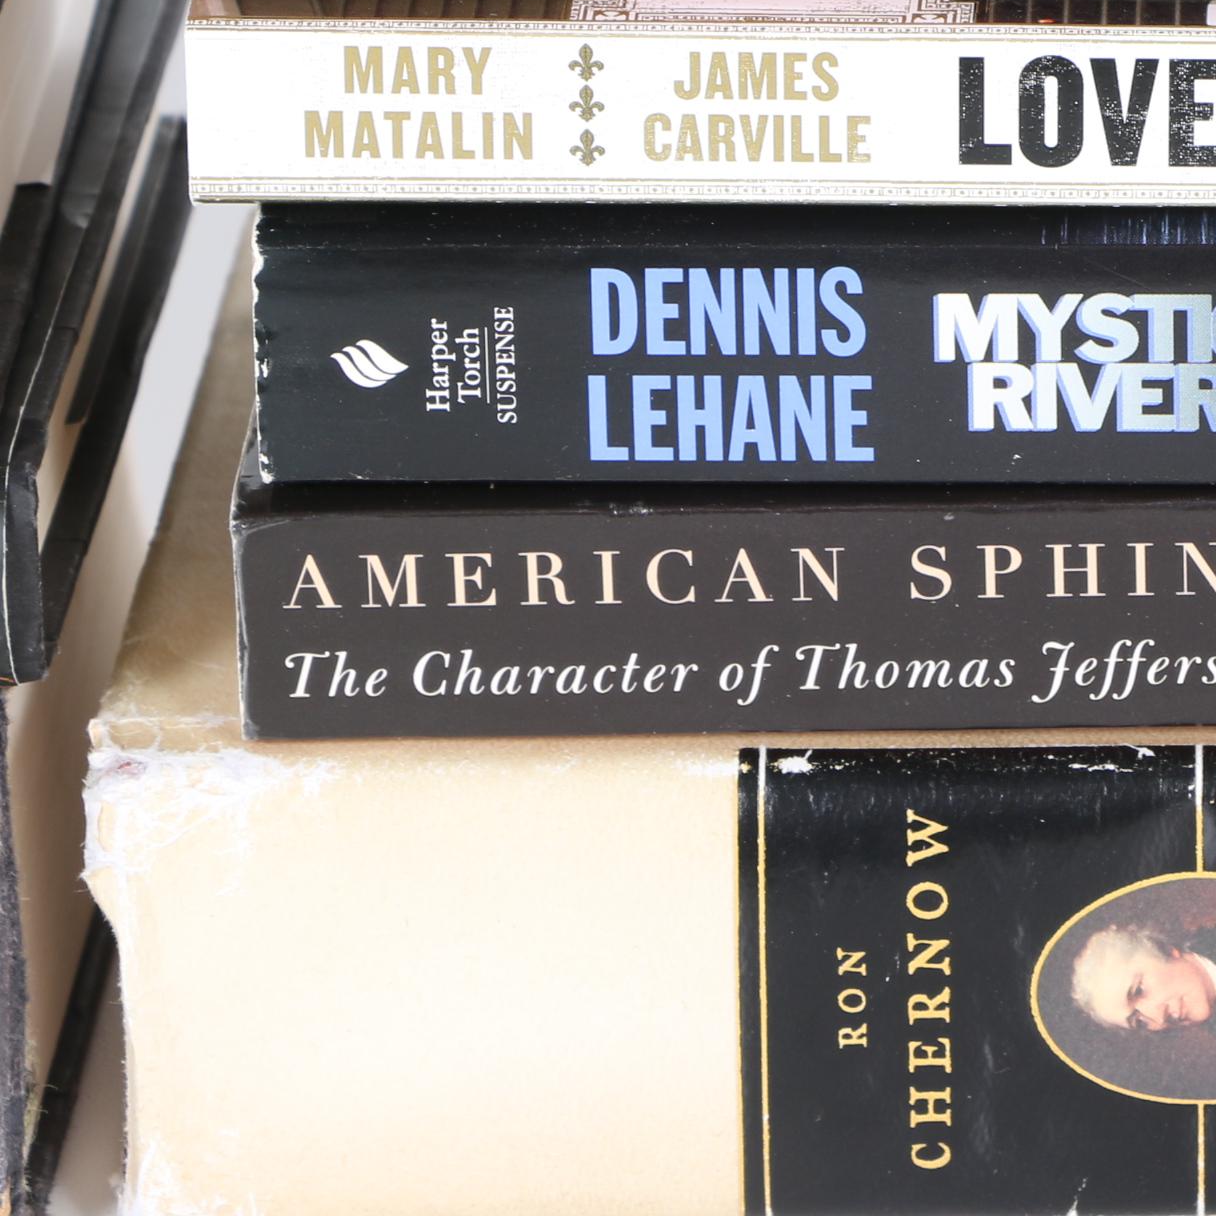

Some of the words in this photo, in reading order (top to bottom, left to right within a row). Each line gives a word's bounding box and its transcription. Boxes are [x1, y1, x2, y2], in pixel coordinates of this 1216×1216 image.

[343, 45, 493, 96] MARY
[673, 51, 840, 103] JAMES
[304, 110, 533, 161] MATALIN
[643, 112, 872, 164] CARVILLE
[590, 266, 867, 357] DENNIS
[426, 318, 452, 413] Harper
[455, 327, 482, 404] Torch
[494, 306, 518, 424] SUSPENSE
[587, 374, 875, 462] LEHANE
[282, 547, 845, 609] AMERICAN
[284, 650, 388, 698] The
[412, 648, 699, 697] Character
[719, 644, 780, 706] of
[795, 643, 1016, 690] Thomas
[836, 947, 868, 1049] RON
[905, 808, 952, 1170] CHERNOW
